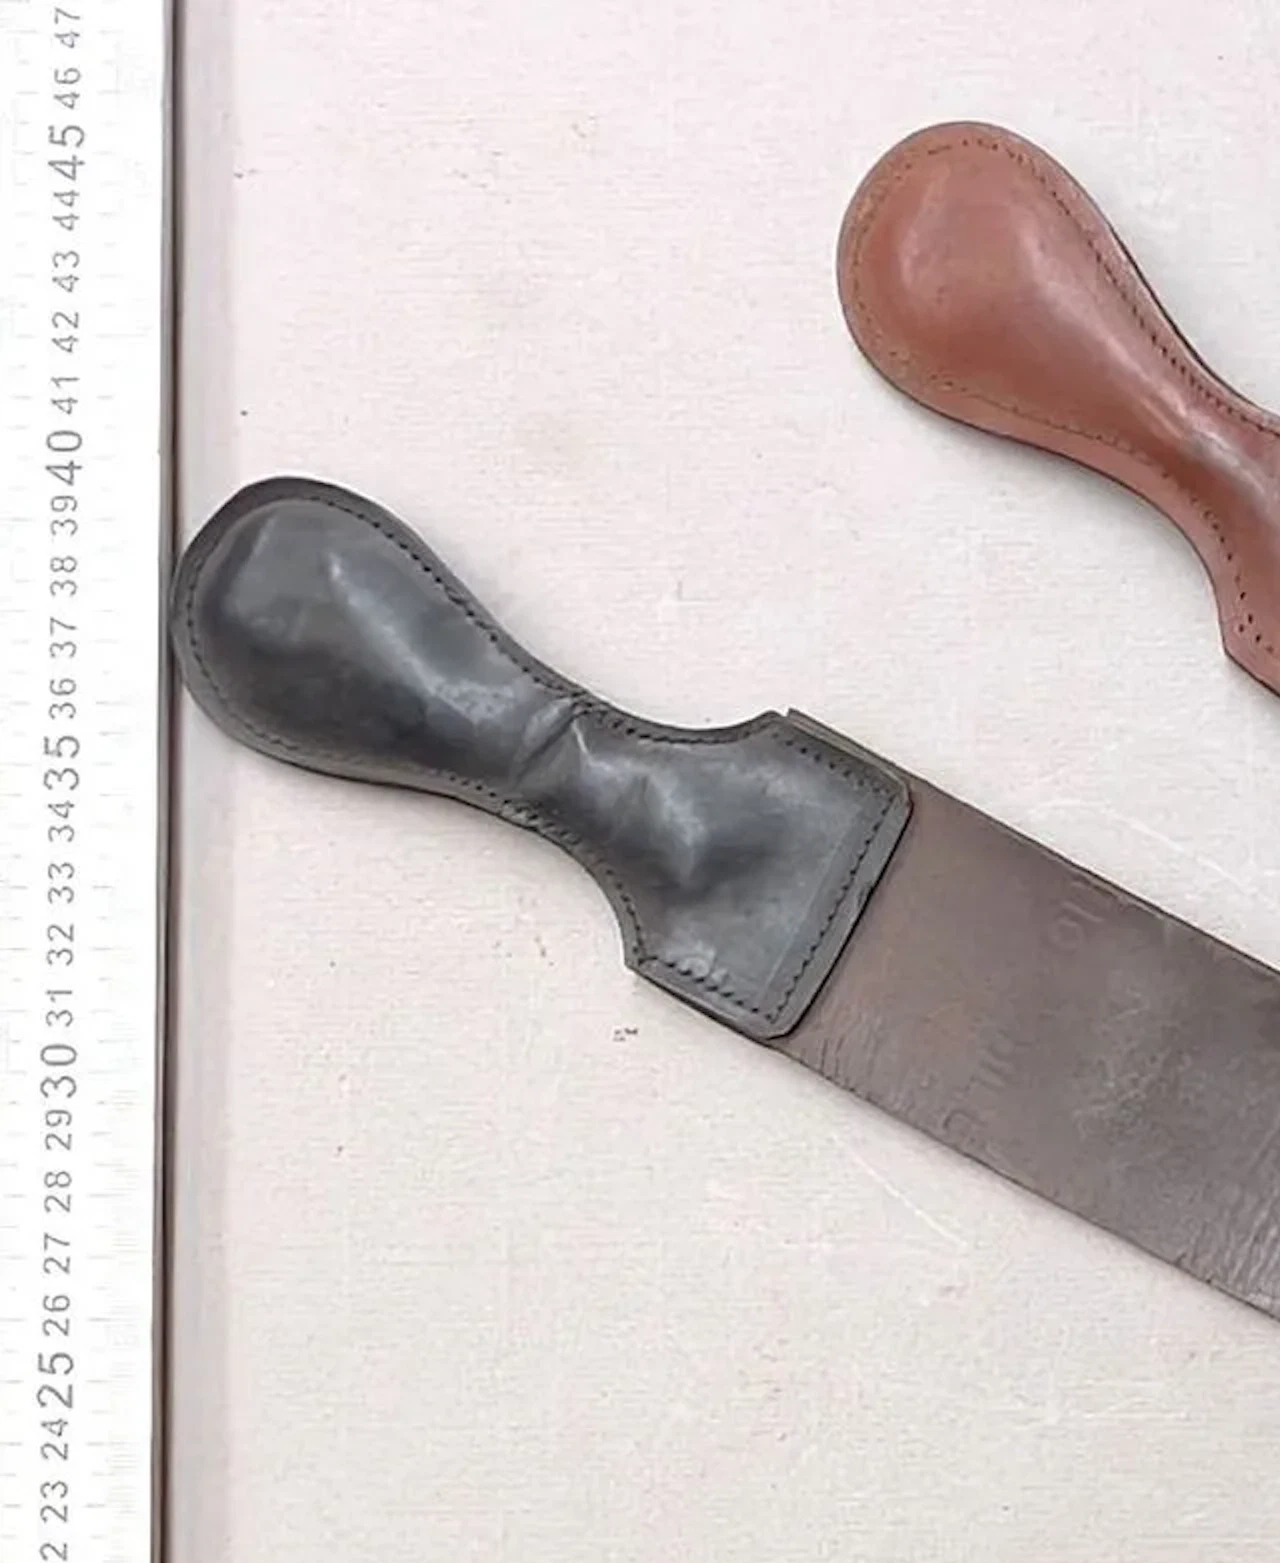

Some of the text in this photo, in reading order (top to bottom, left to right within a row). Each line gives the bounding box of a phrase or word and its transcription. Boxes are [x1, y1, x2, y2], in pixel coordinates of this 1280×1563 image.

[53, 7, 80, 48] 47
[53, 67, 81, 109] 46
[47, 125, 85, 180] 45
[51, 189, 79, 231] 44
[51, 250, 79, 292] 43
[51, 311, 79, 353] 42
[50, 376, 79, 415] 41
[44, 429, 82, 486] 40
[49, 495, 78, 535] 39
[49, 555, 77, 596] 38
[48, 616, 77, 658] 37
[48, 677, 76, 719] 36
[43, 735, 80, 790] 35
[47, 800, 75, 842] 34
[47, 861, 74, 903] 33
[45, 924, 74, 966] 32
[45, 989, 73, 1027] 31
[39, 1043, 77, 1098] 30
[44, 1109, 72, 1150] 29
[43, 1170, 72, 1212] 28
[42, 1232, 70, 1274] 27
[42, 1294, 70, 1336] 26
[35, 1352, 74, 1408] 25
[40, 1418, 68, 1460] 24
[39, 1480, 68, 1523] 23
